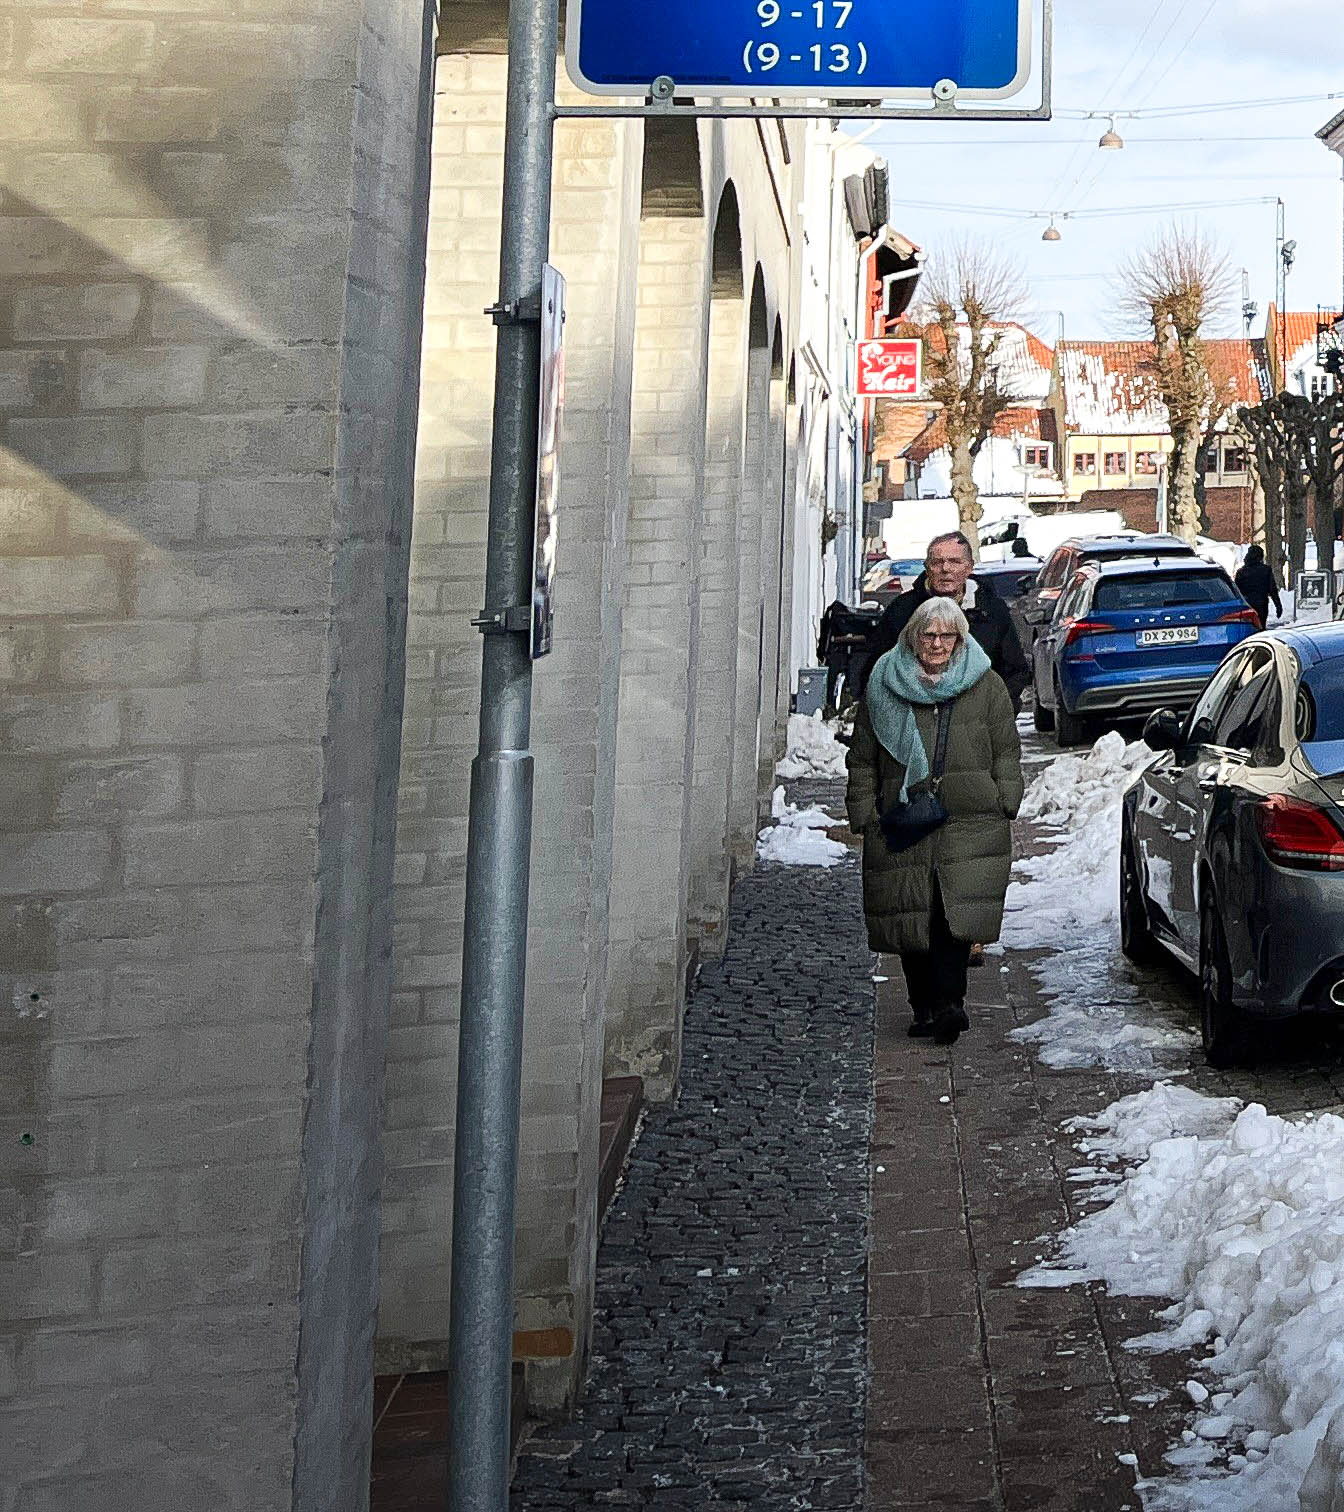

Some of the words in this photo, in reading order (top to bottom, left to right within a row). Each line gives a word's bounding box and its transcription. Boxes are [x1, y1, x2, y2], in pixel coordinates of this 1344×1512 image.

[875, 355, 916, 366] YOUNG
[1144, 631, 1159, 643] DX
[1162, 630, 1175, 641] 29
[1177, 628, 1197, 639] 984
